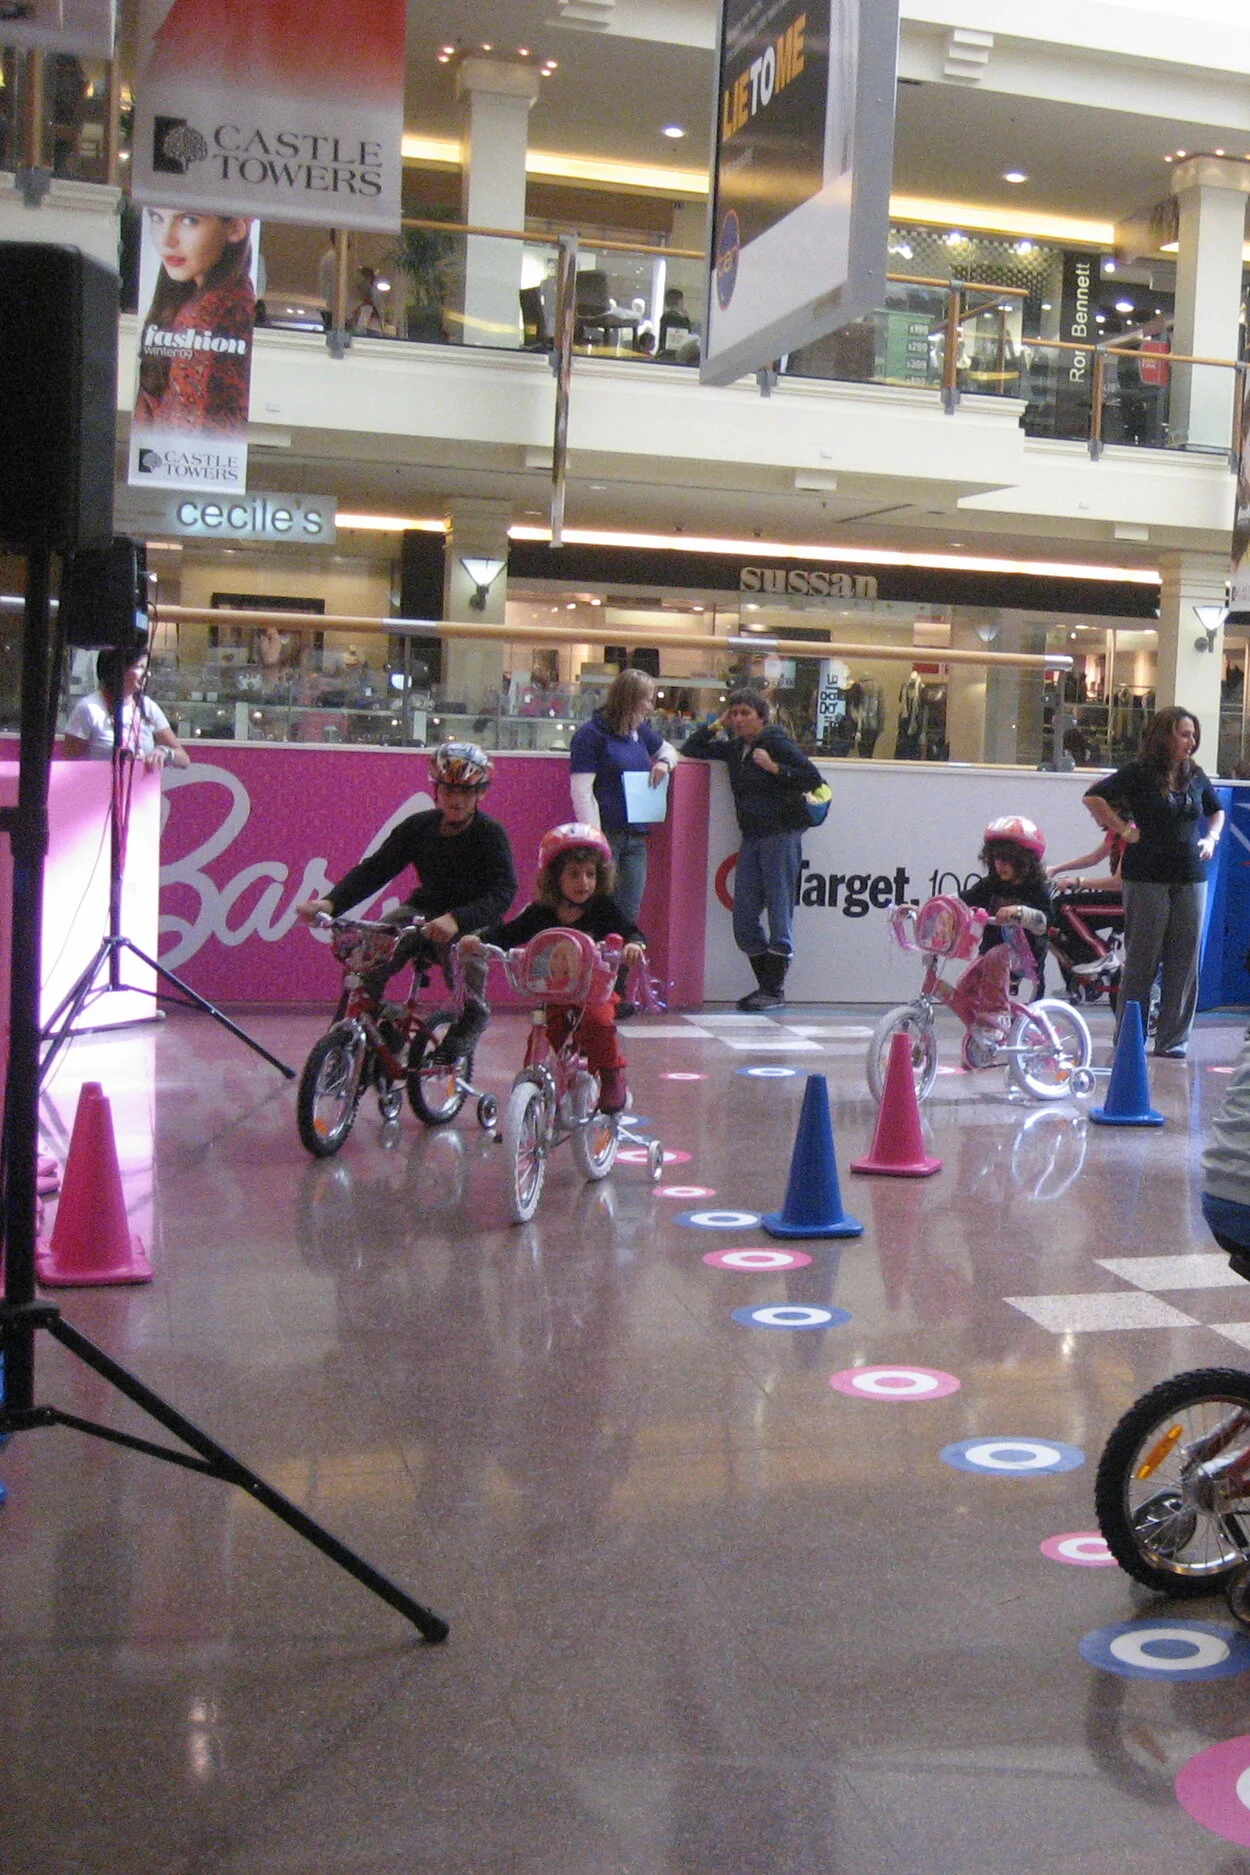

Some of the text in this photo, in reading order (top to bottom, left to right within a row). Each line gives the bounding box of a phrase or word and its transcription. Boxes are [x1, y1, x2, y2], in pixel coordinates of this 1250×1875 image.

[213, 123, 384, 168] CASTLE
[212, 153, 384, 197] TOWERS
[1071, 263, 1091, 337] Bennett
[145, 325, 247, 355] fashion
[164, 450, 239, 468] CASTLE
[164, 464, 239, 481] TOWERS
[177, 500, 323, 535] cecile's
[740, 567, 879, 600] sussan
